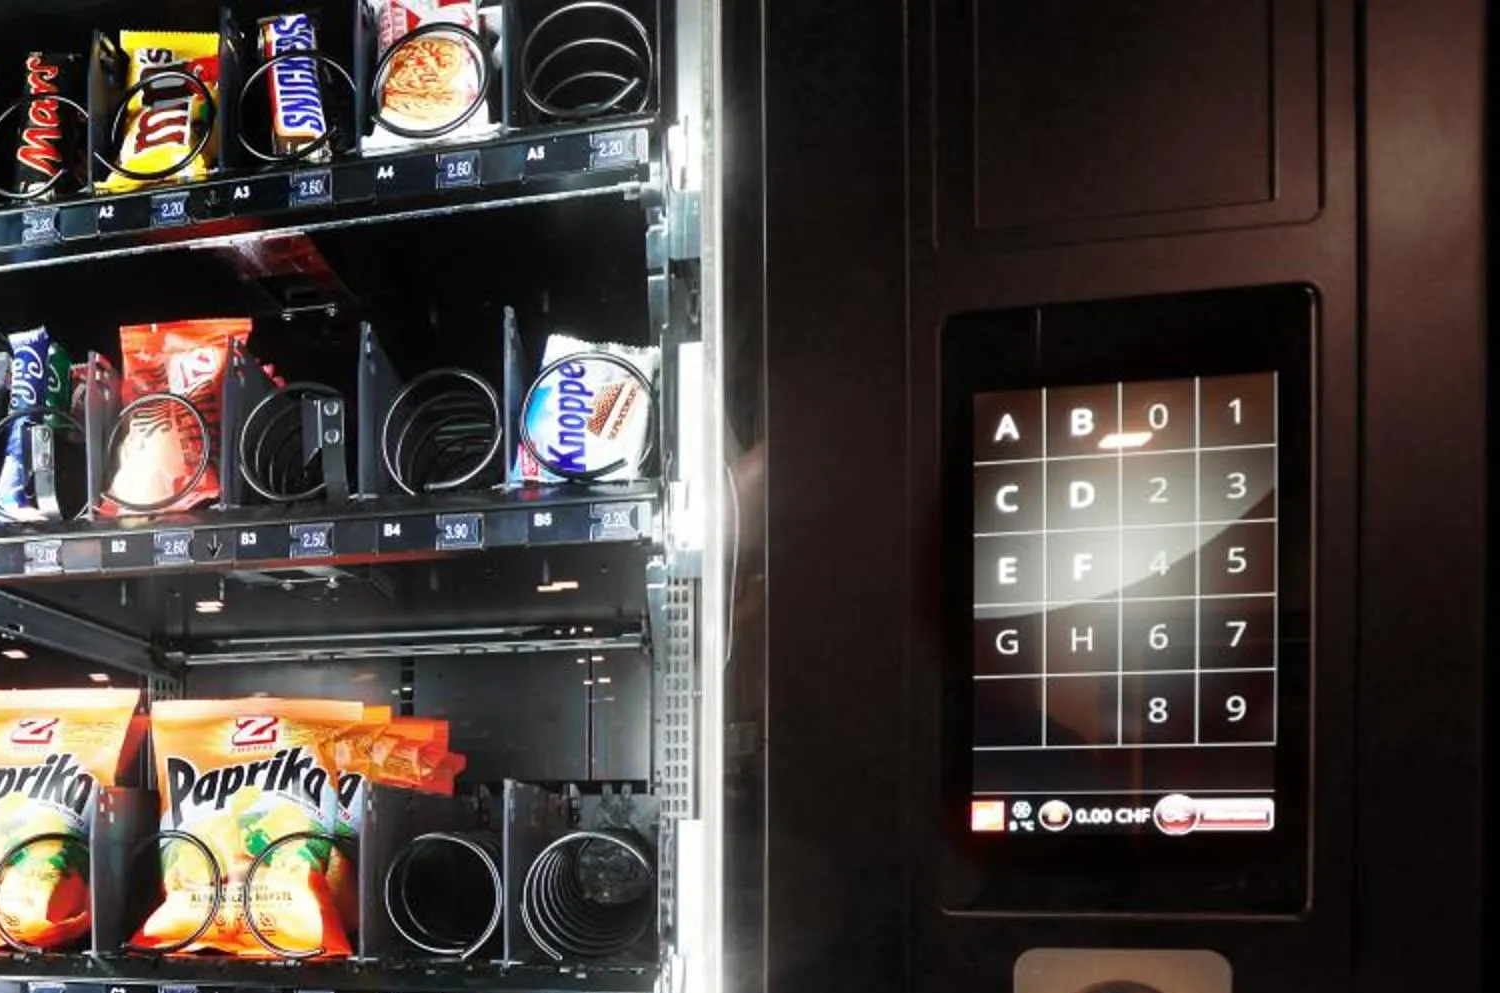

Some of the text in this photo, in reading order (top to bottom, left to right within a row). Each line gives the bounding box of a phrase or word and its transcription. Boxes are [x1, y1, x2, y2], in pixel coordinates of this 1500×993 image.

[16, 55, 62, 177] Mars
[527, 146, 545, 161] A5
[377, 165, 395, 179] A4
[234, 186, 250, 199] A3
[99, 205, 115, 219] A2
[547, 360, 593, 473] Knoppe
[1070, 408, 1095, 437] B
[1148, 403, 1169, 430] 0
[1228, 398, 1241, 426] 1
[994, 413, 1020, 442] A
[1069, 481, 1095, 509] D
[1148, 477, 1169, 503] 2
[1226, 472, 1247, 499] 3
[995, 485, 1019, 513] C
[383, 523, 401, 537] B4
[533, 512, 553, 527] B5
[111, 540, 127, 553] B2
[241, 532, 257, 545] B3
[997, 557, 1018, 584] E
[1073, 553, 1093, 580] F
[1148, 551, 1170, 576] 4
[1226, 548, 1247, 573] 5
[995, 629, 1019, 655] G
[1071, 627, 1093, 652] H
[1148, 624, 1169, 650] 6
[1226, 621, 1247, 648] 7
[1148, 697, 1168, 723] 8
[1225, 695, 1247, 722] 9
[232, 714, 279, 746] Z
[167, 747, 328, 829] Paprika
[1075, 808, 1152, 825] 0.00 CHF
